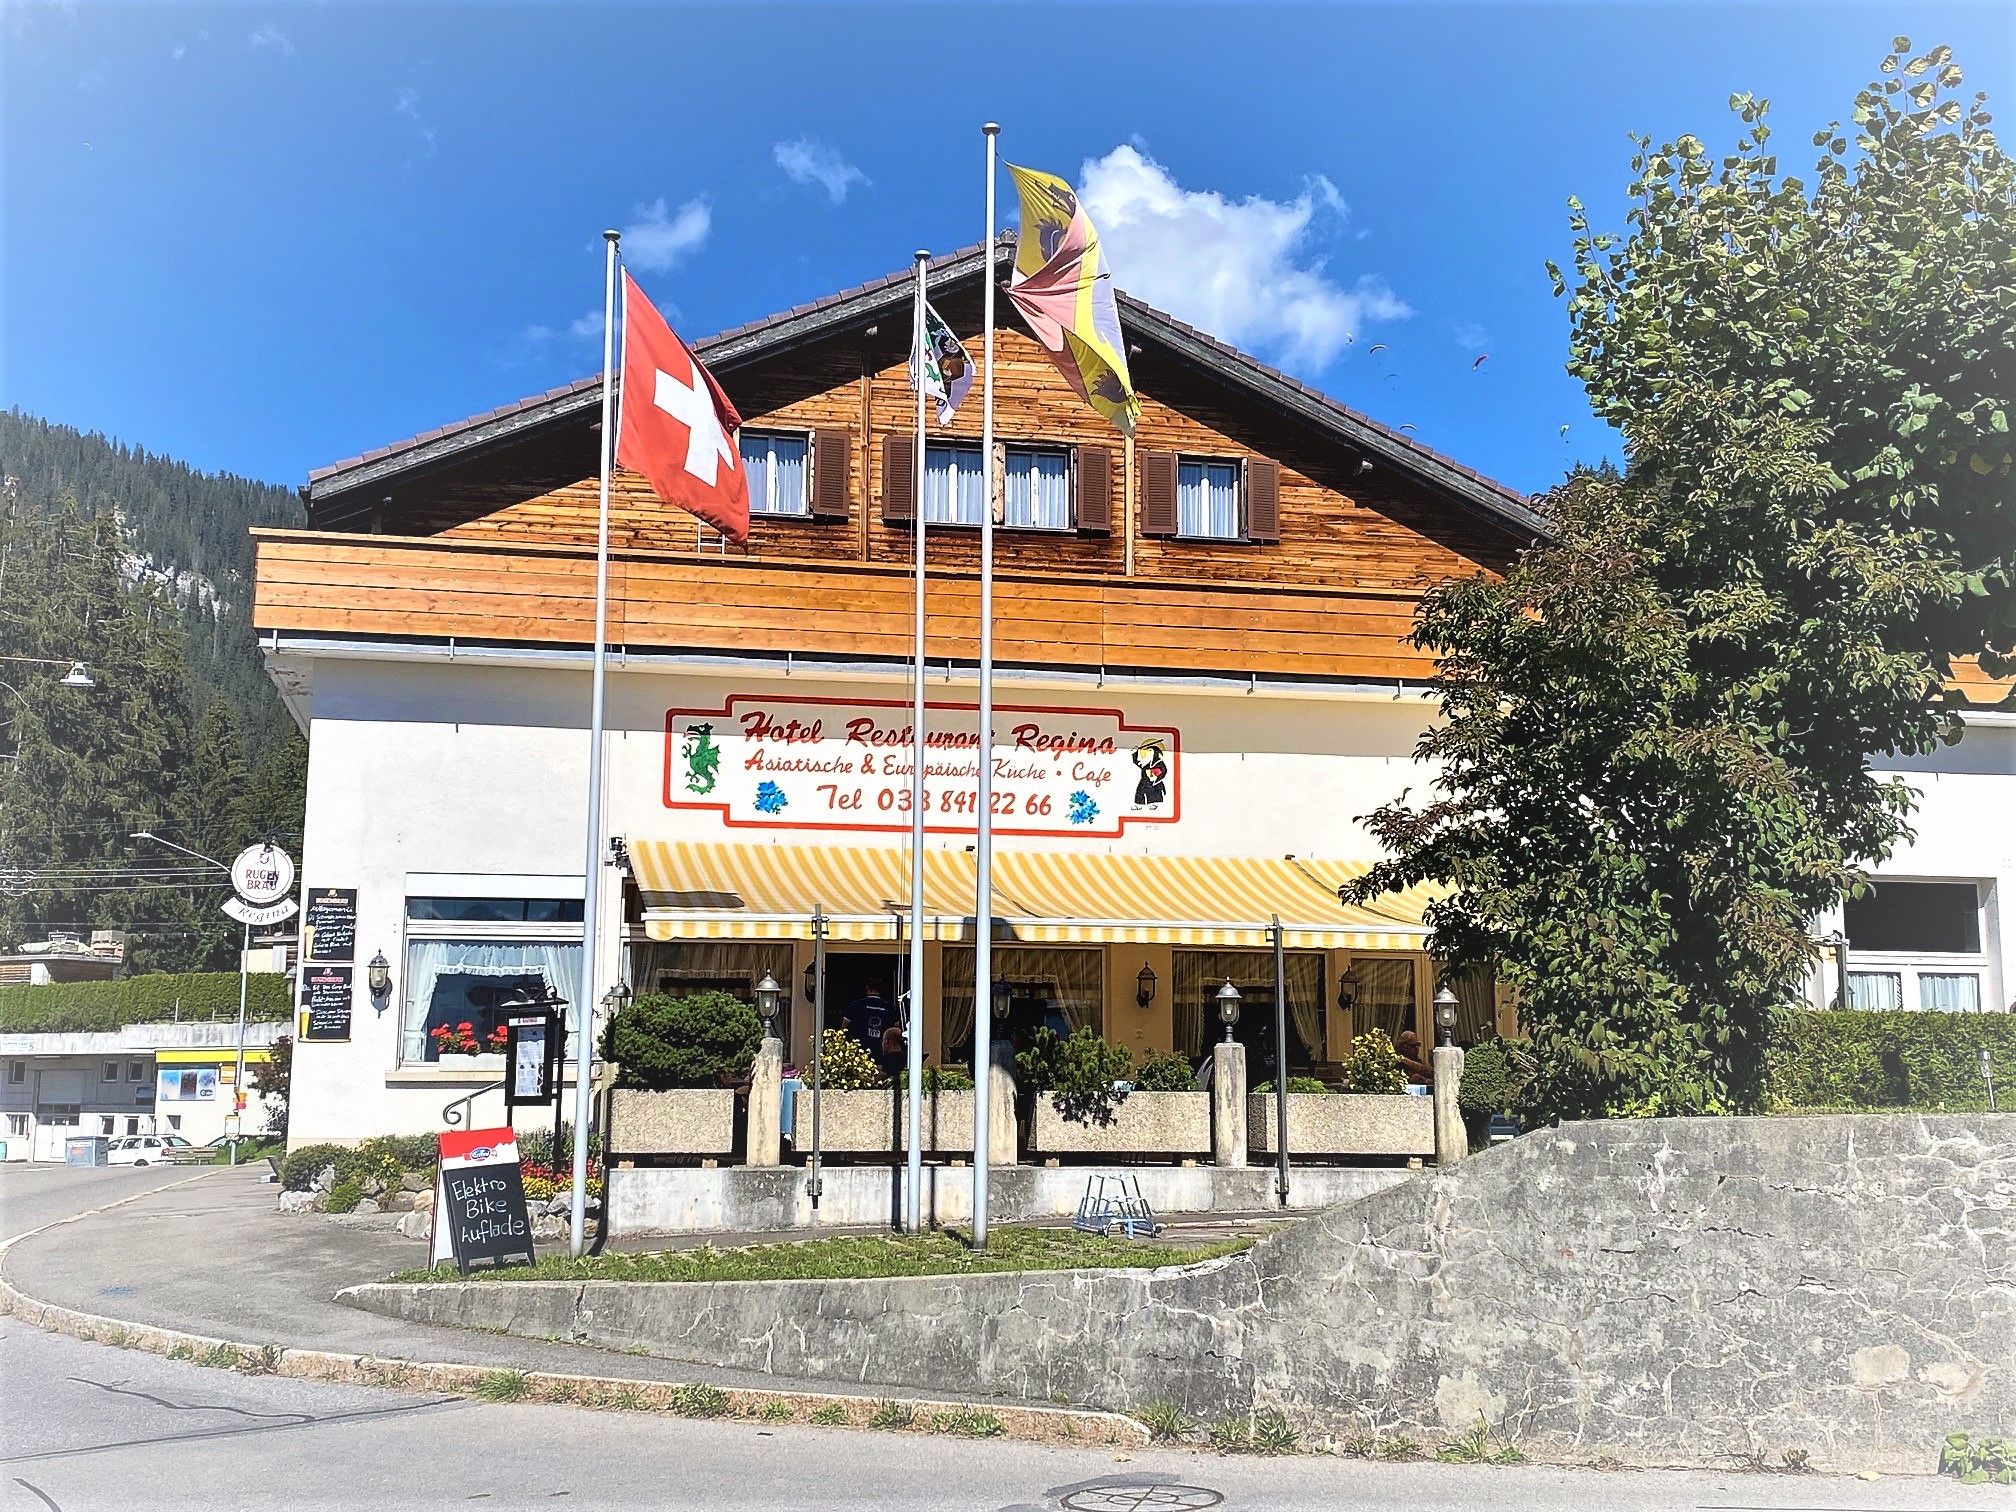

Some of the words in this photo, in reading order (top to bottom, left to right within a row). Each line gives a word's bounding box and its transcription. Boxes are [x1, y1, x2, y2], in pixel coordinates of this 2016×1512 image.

[740, 711, 825, 746] Hotel
[846, 717, 996, 751] Resturan
[1011, 723, 1117, 761] Regina
[744, 748, 853, 775] Asiatische
[860, 753, 876, 775] &
[883, 754, 981, 781] Eurpäische
[990, 758, 1046, 780] Küche
[1072, 762, 1112, 787] Cafe
[816, 784, 863, 810] Tel
[940, 790, 977, 813] 841
[989, 792, 1015, 814] 22
[1025, 793, 1052, 815] 66
[245, 869, 280, 880] RUGEN
[237, 905, 289, 922] Regina
[452, 1177, 506, 1201] Elektro
[466, 1197, 507, 1219] Bike
[462, 1214, 525, 1244] Auflade
